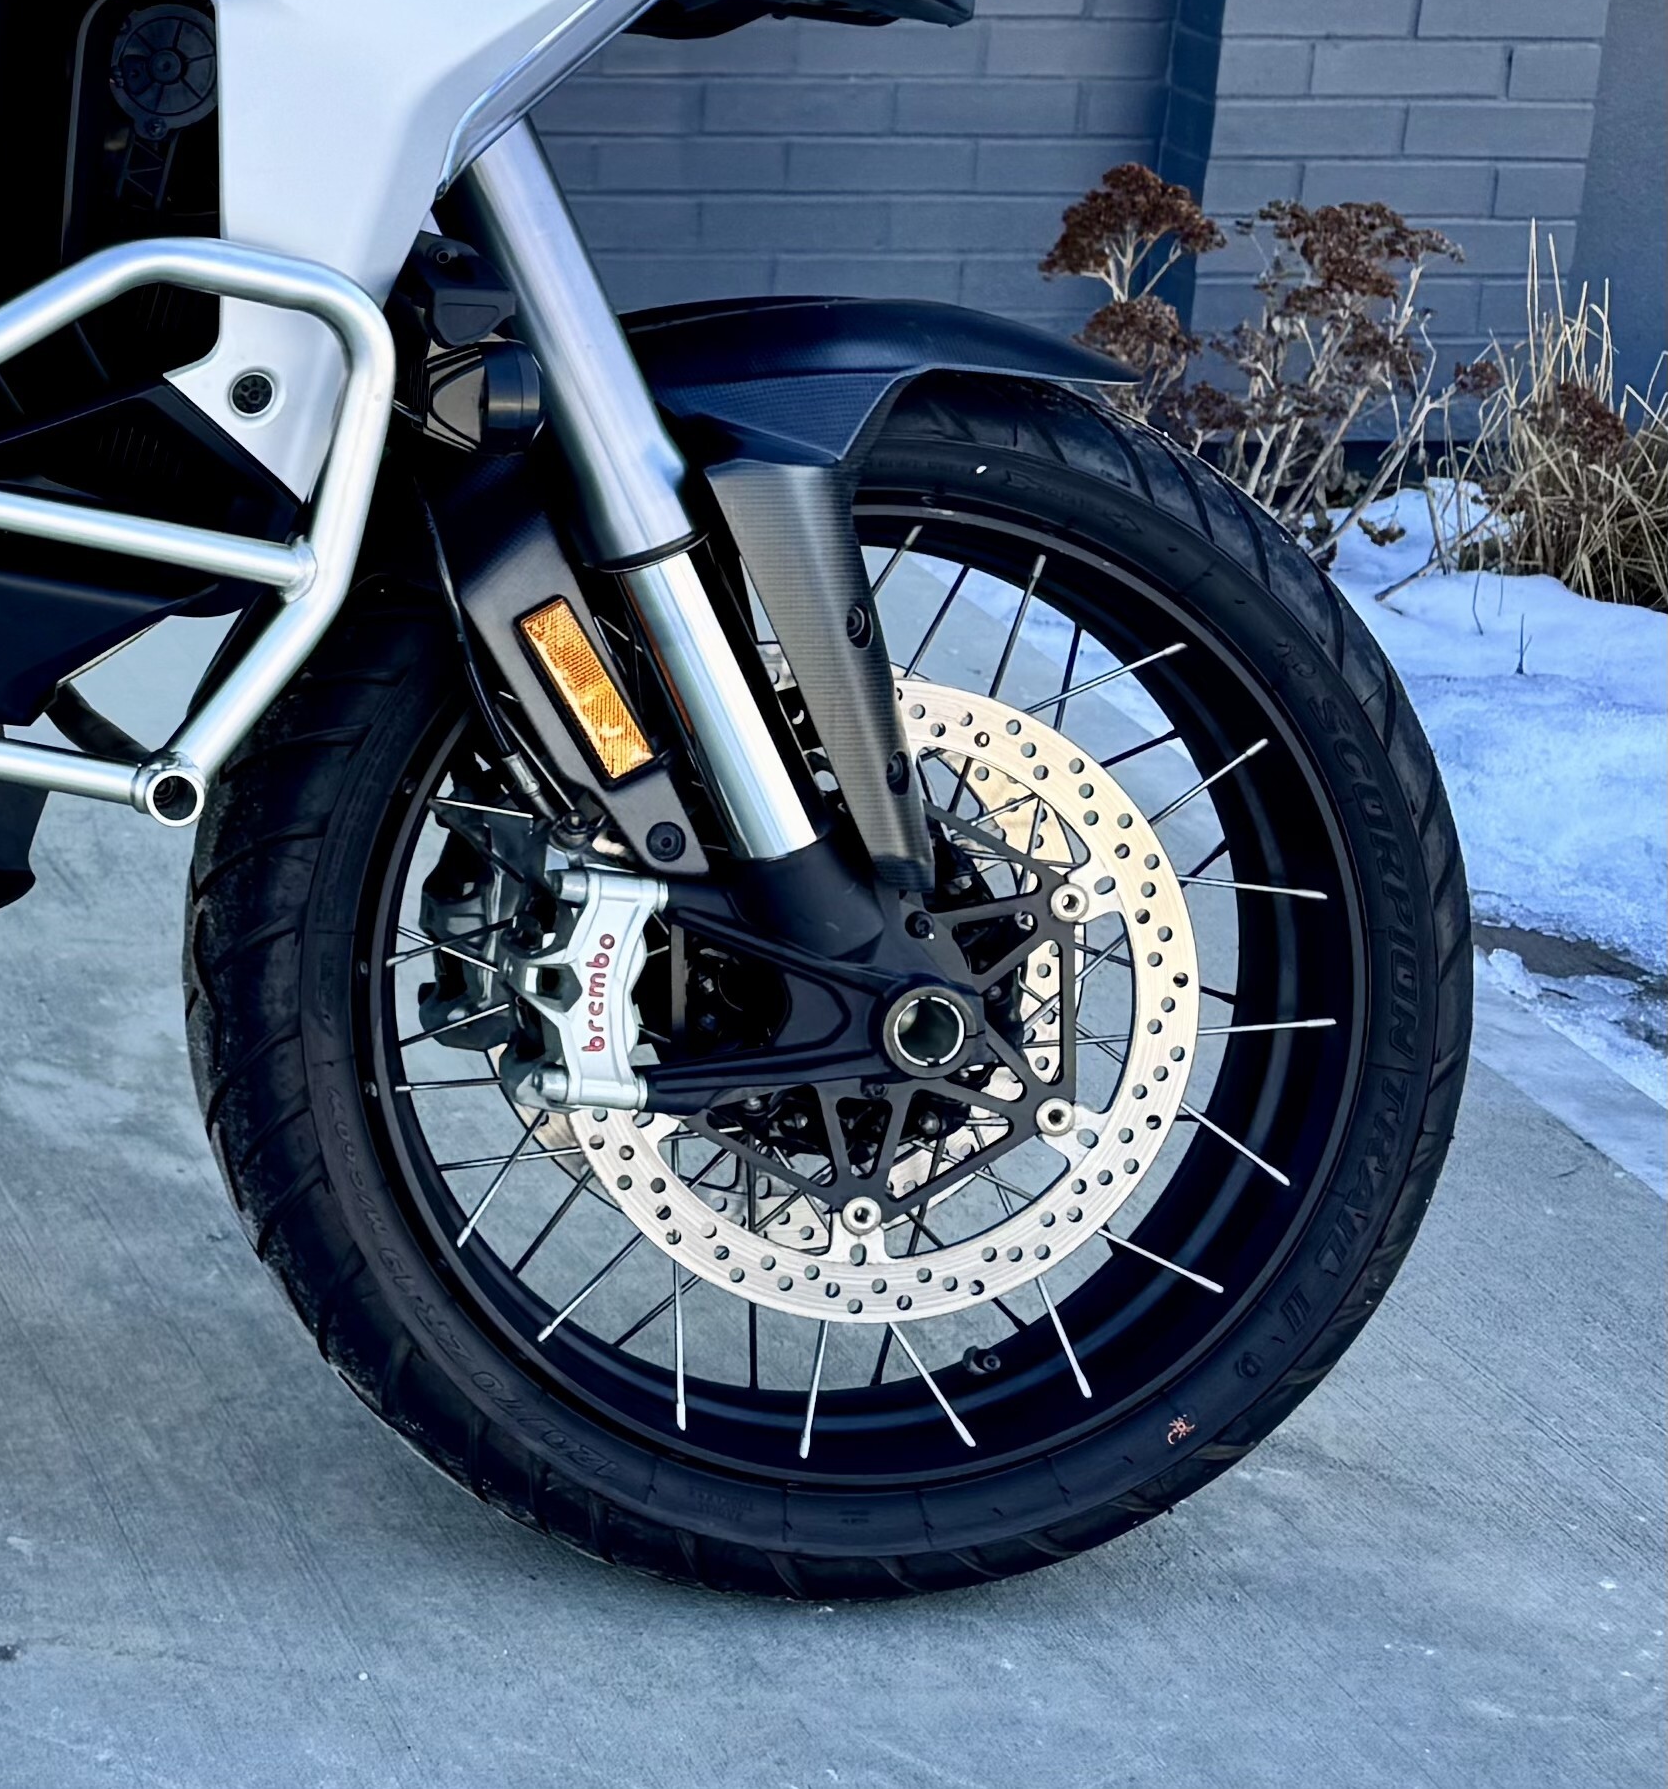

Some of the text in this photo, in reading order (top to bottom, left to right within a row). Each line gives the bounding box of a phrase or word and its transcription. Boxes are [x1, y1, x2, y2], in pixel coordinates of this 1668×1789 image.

[1306, 695, 1421, 1062] SCORPION
[581, 933, 616, 1053] brembo
[1315, 1075, 1410, 1269] TRAIL
